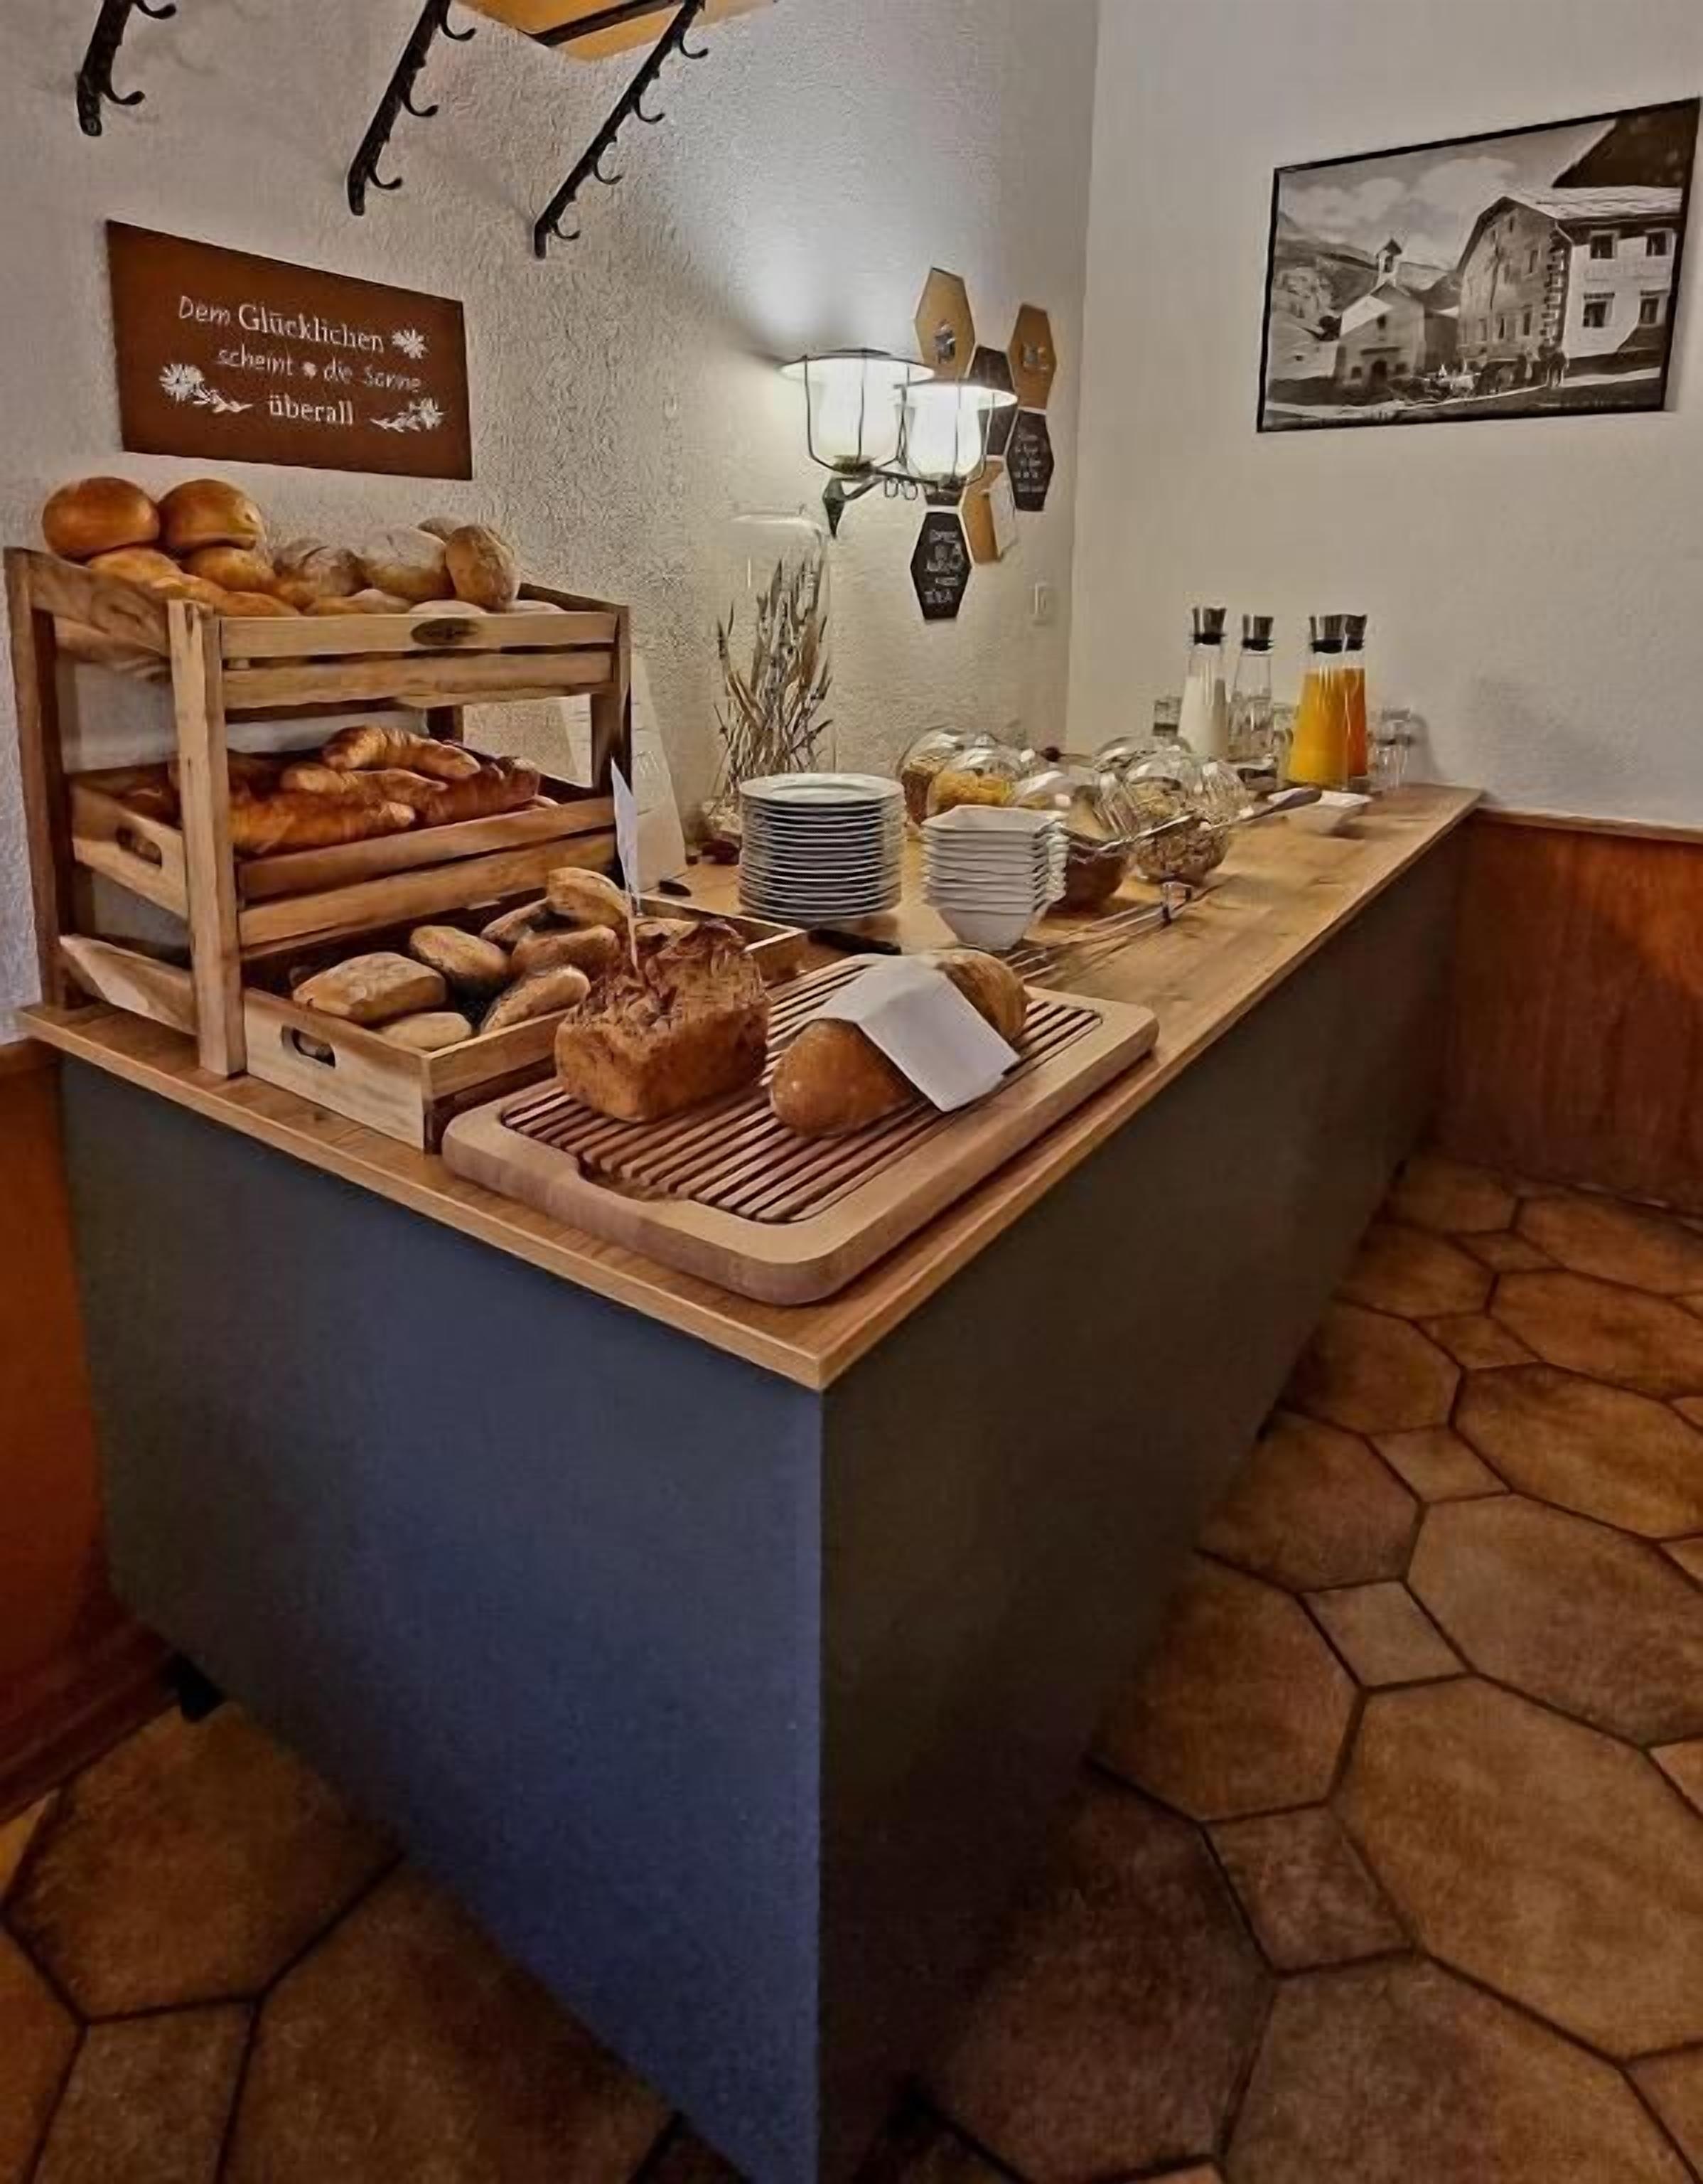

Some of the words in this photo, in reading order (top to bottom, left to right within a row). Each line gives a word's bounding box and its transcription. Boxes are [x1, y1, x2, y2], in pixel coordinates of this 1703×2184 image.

[179, 296, 231, 326] Dem
[239, 304, 383, 353] Glücklichen
[216, 344, 294, 376] scheint
[323, 355, 353, 382] die
[269, 394, 353, 425] überall
